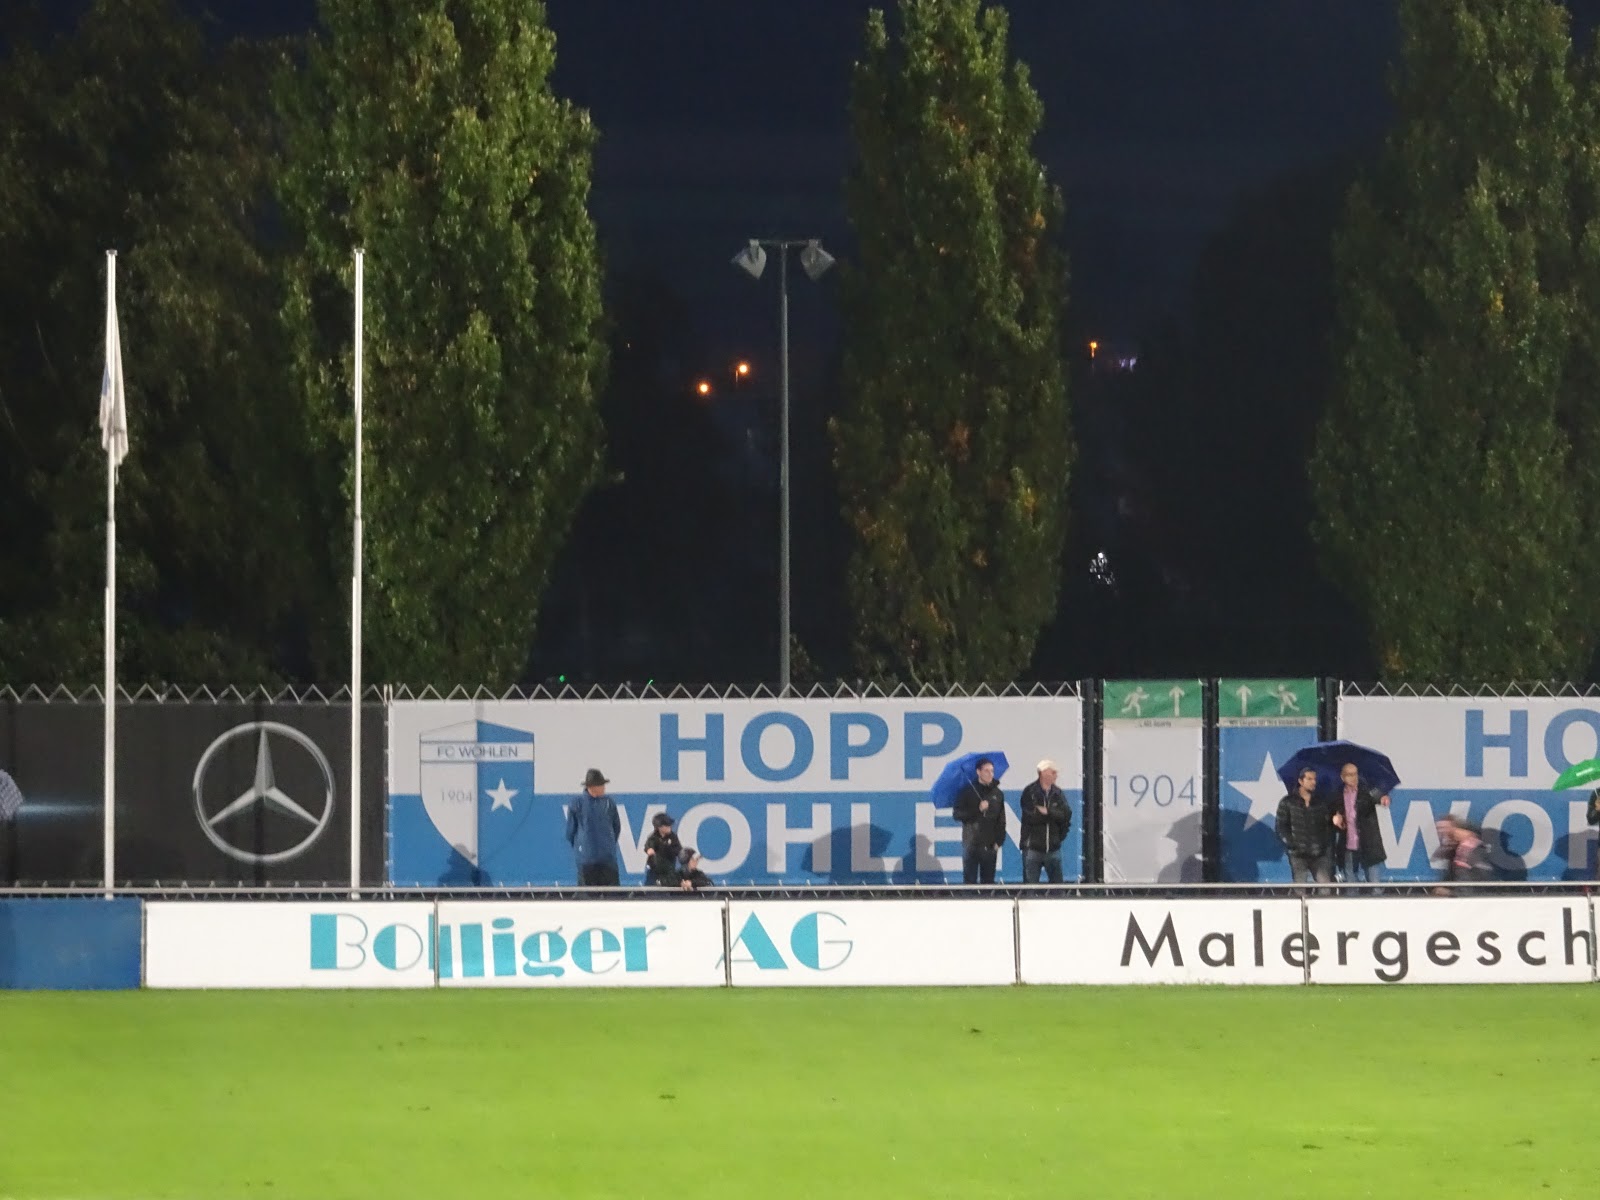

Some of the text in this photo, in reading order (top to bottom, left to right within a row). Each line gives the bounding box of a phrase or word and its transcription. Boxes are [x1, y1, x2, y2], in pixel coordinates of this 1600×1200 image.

[437, 745, 518, 758] FC WOHLEN
[660, 711, 963, 781] HOPP
[440, 790, 473, 805] 1904
[1109, 774, 1197, 807] 1904
[310, 910, 854, 977] Bolliger AG
[1120, 906, 1595, 982] Malergesch
